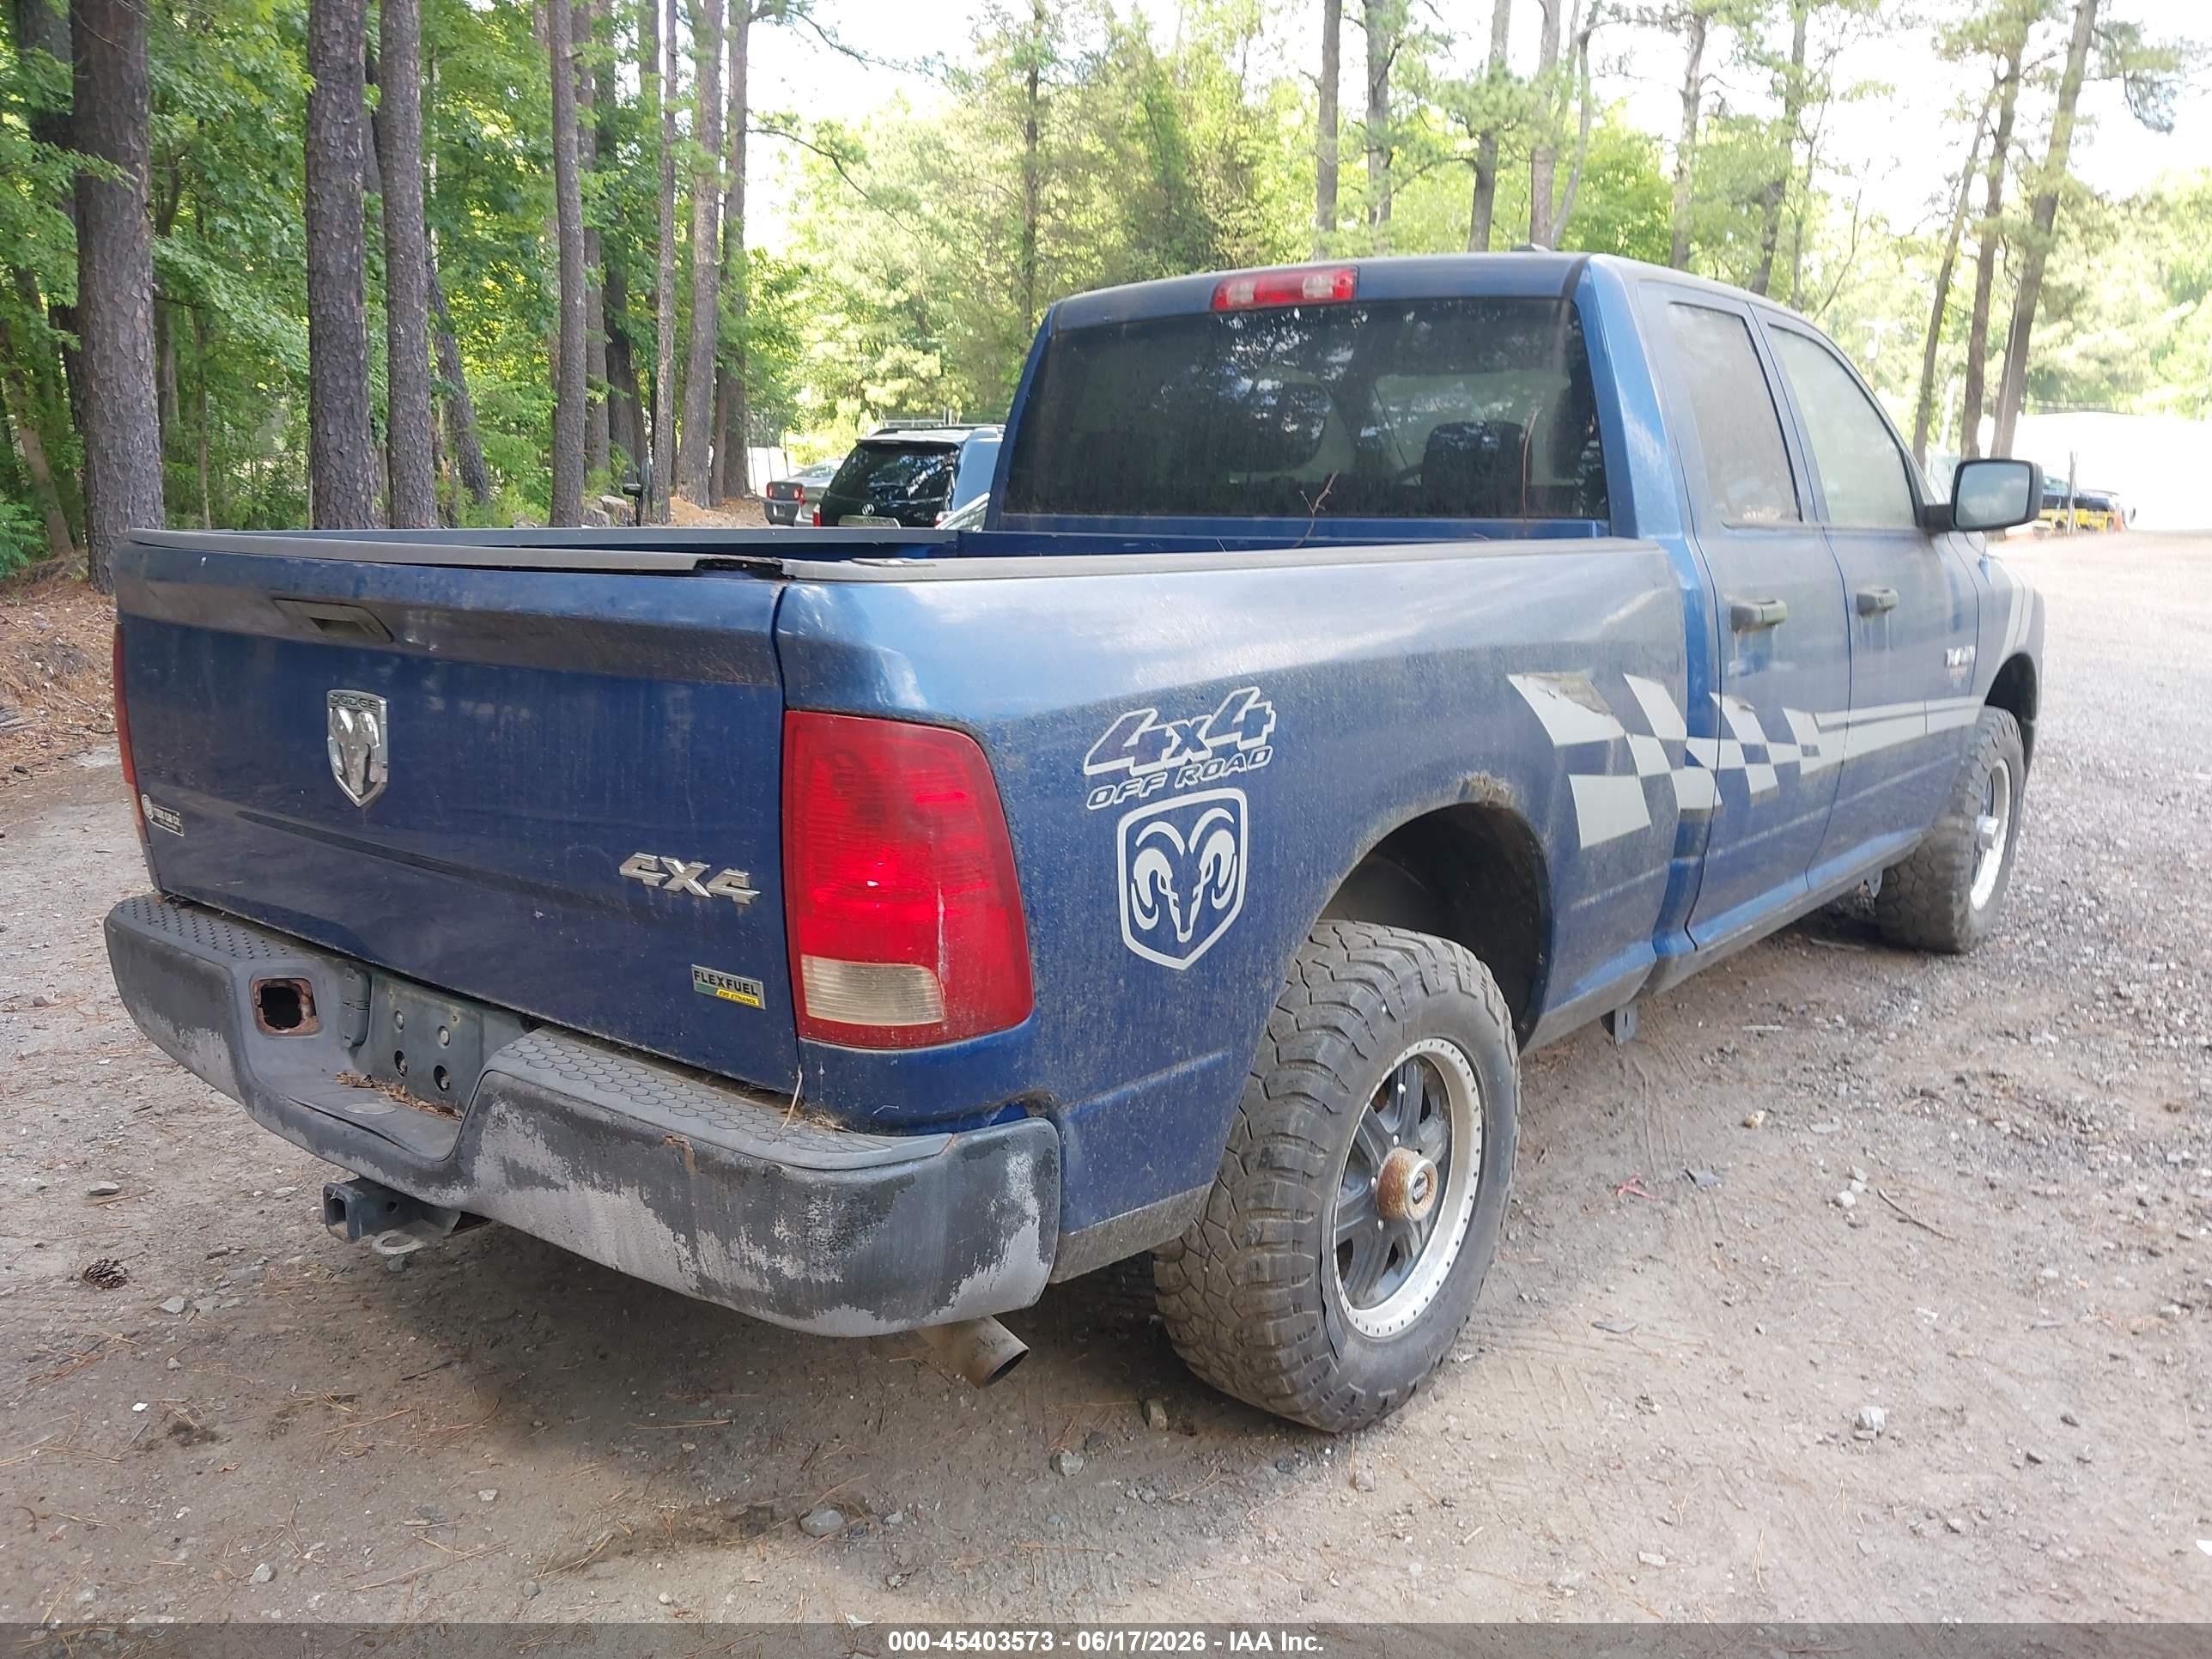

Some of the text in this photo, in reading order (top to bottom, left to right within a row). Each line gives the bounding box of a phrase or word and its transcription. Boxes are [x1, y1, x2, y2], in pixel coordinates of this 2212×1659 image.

[329, 694, 378, 712] DODGE
[1086, 744, 1273, 811] OFF ROAD
[693, 969, 758, 996] FLEXFUEL
